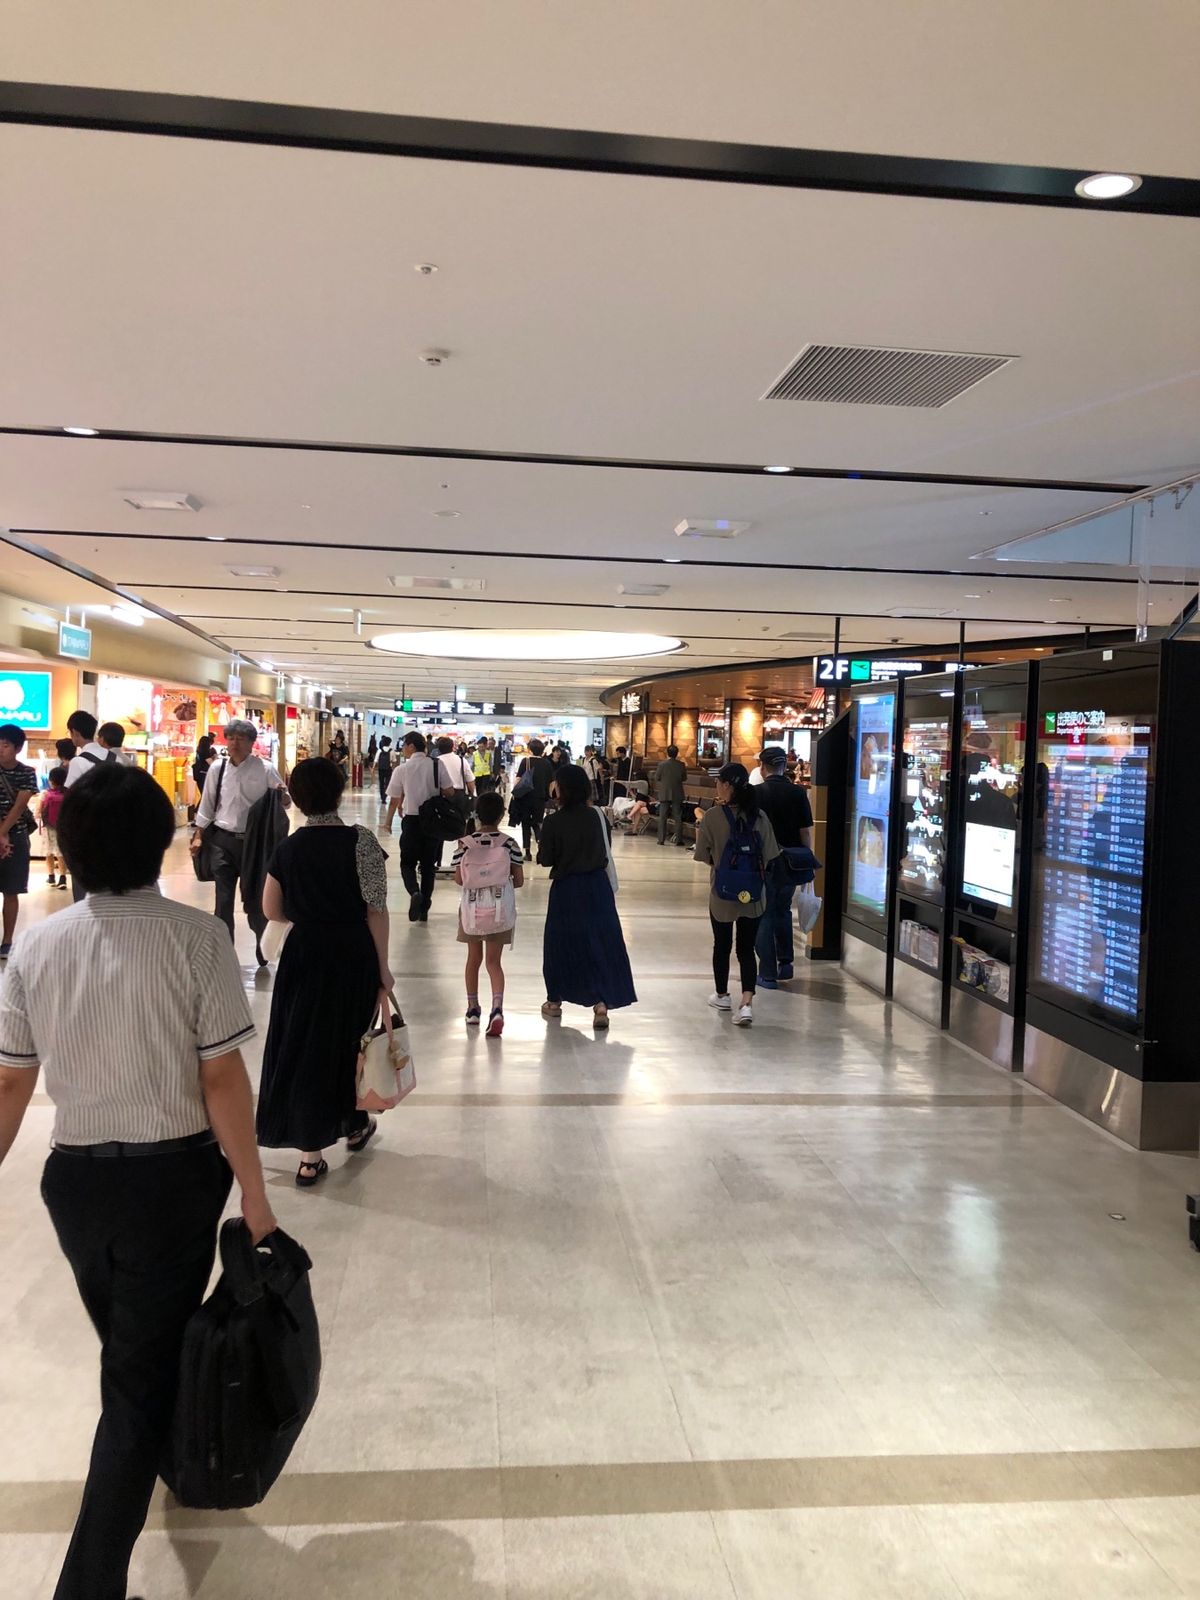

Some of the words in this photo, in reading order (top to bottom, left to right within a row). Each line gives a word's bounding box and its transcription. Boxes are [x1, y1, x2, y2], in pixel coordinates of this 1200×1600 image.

[819, 659, 849, 680] 2F
[1057, 710, 1105, 726] 出発便のご案内
